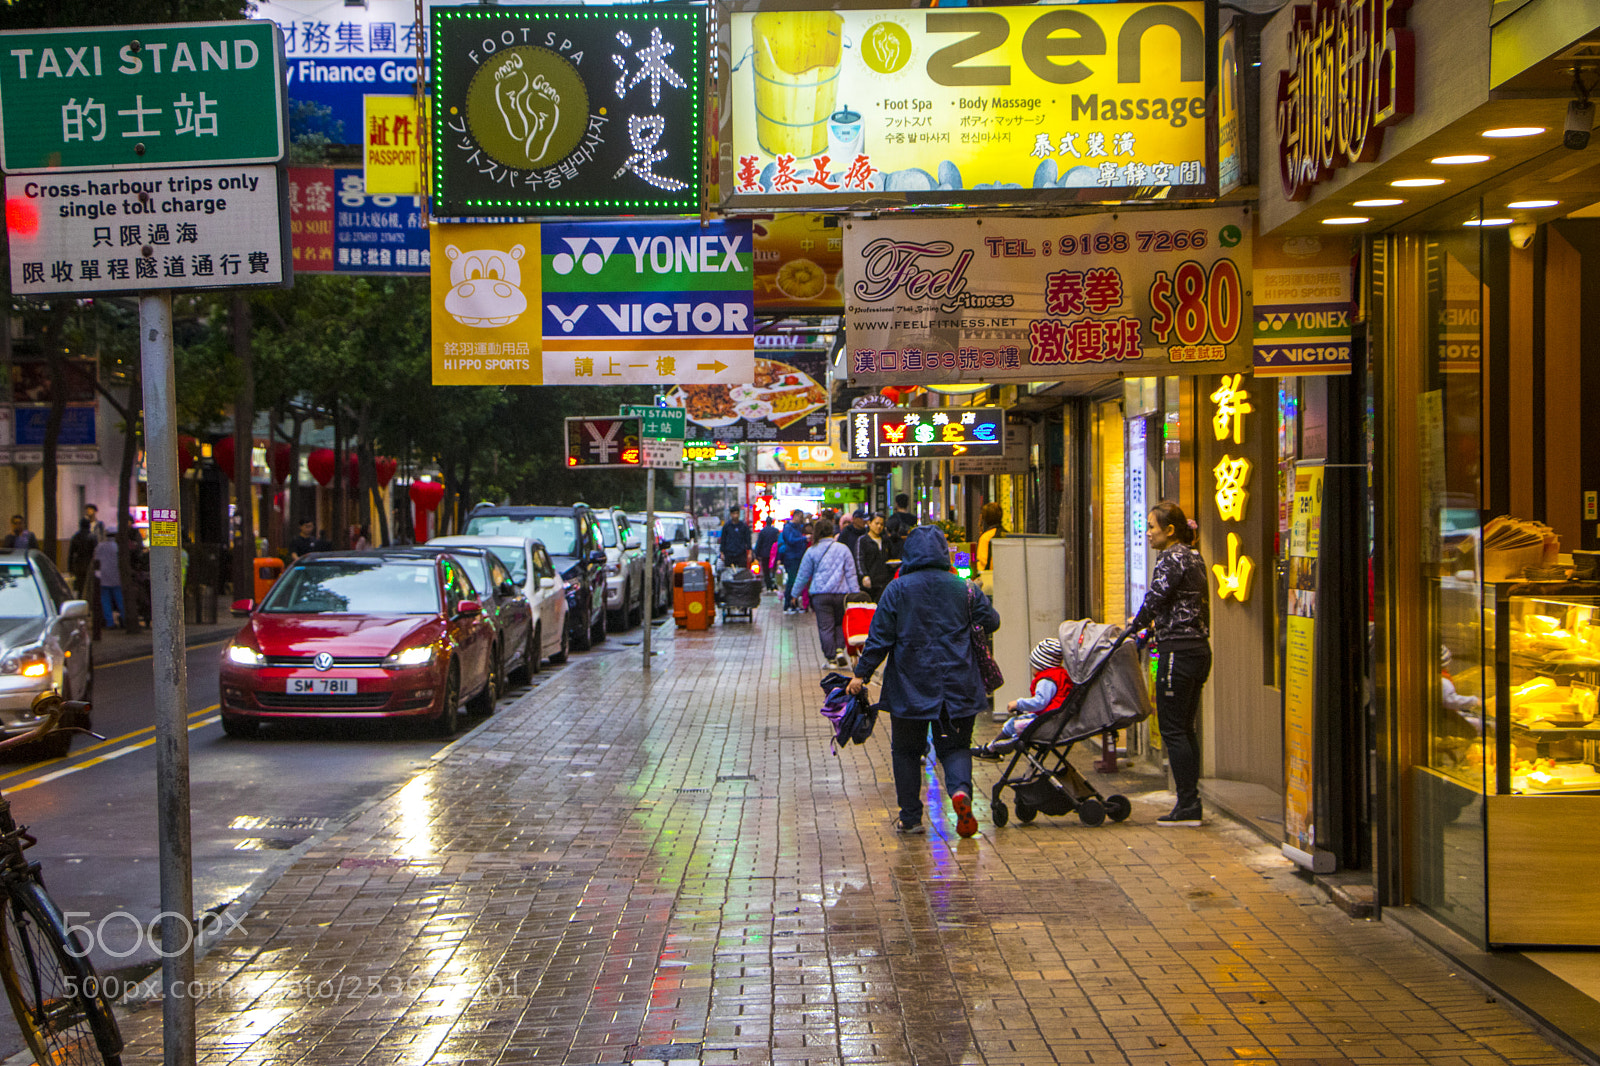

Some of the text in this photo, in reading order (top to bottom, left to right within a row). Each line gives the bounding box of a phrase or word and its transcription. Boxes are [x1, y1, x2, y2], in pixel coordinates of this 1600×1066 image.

[468, 27, 584, 66] FOOT SPA
[926, 5, 1204, 86] zen
[10, 39, 259, 80] TAXI STAND
[298, 60, 376, 83] Finance
[62, 91, 219, 143] 的士站
[884, 99, 932, 112] Foot Spa
[959, 97, 1041, 111] Body Massage
[1071, 94, 1205, 128] Massage
[919, 132, 950, 143] 마사지
[1030, 131, 1136, 158] 泰式裝潢
[369, 150, 416, 166] PASSPORT
[24, 174, 259, 199] Cross-harbour trips only
[1097, 160, 1201, 187] 寧靜空間
[59, 197, 227, 220] single toll charge
[93, 222, 199, 248] 只限過海
[1060, 231, 1129, 255] 9188
[1136, 229, 1208, 252] 7266
[626, 235, 744, 273] YONEX
[21, 251, 270, 284] 限收單程隧道通行費
[854, 238, 974, 302] Feel
[1046, 268, 1124, 315] 泰拳
[1150, 257, 1243, 345] $80
[1264, 286, 1341, 299] HIPPO SPORTS
[597, 302, 748, 333] VICTOR
[853, 317, 1017, 331] WWW.FEELFITNESS.NET
[1294, 311, 1348, 329] YONEX
[443, 342, 530, 356] 銘羽運動用品
[1029, 317, 1143, 366] 激瘦班
[1282, 347, 1350, 362] VICTOR
[444, 359, 530, 370] HIPPO SPORTS
[574, 356, 676, 377] 請上一樓
[854, 345, 1020, 373] 漢口道53號3樓
[648, 410, 683, 418] STAND
[642, 421, 673, 434] 士站
[1210, 373, 1253, 602] 許留山
[320, 680, 348, 691] 7811
